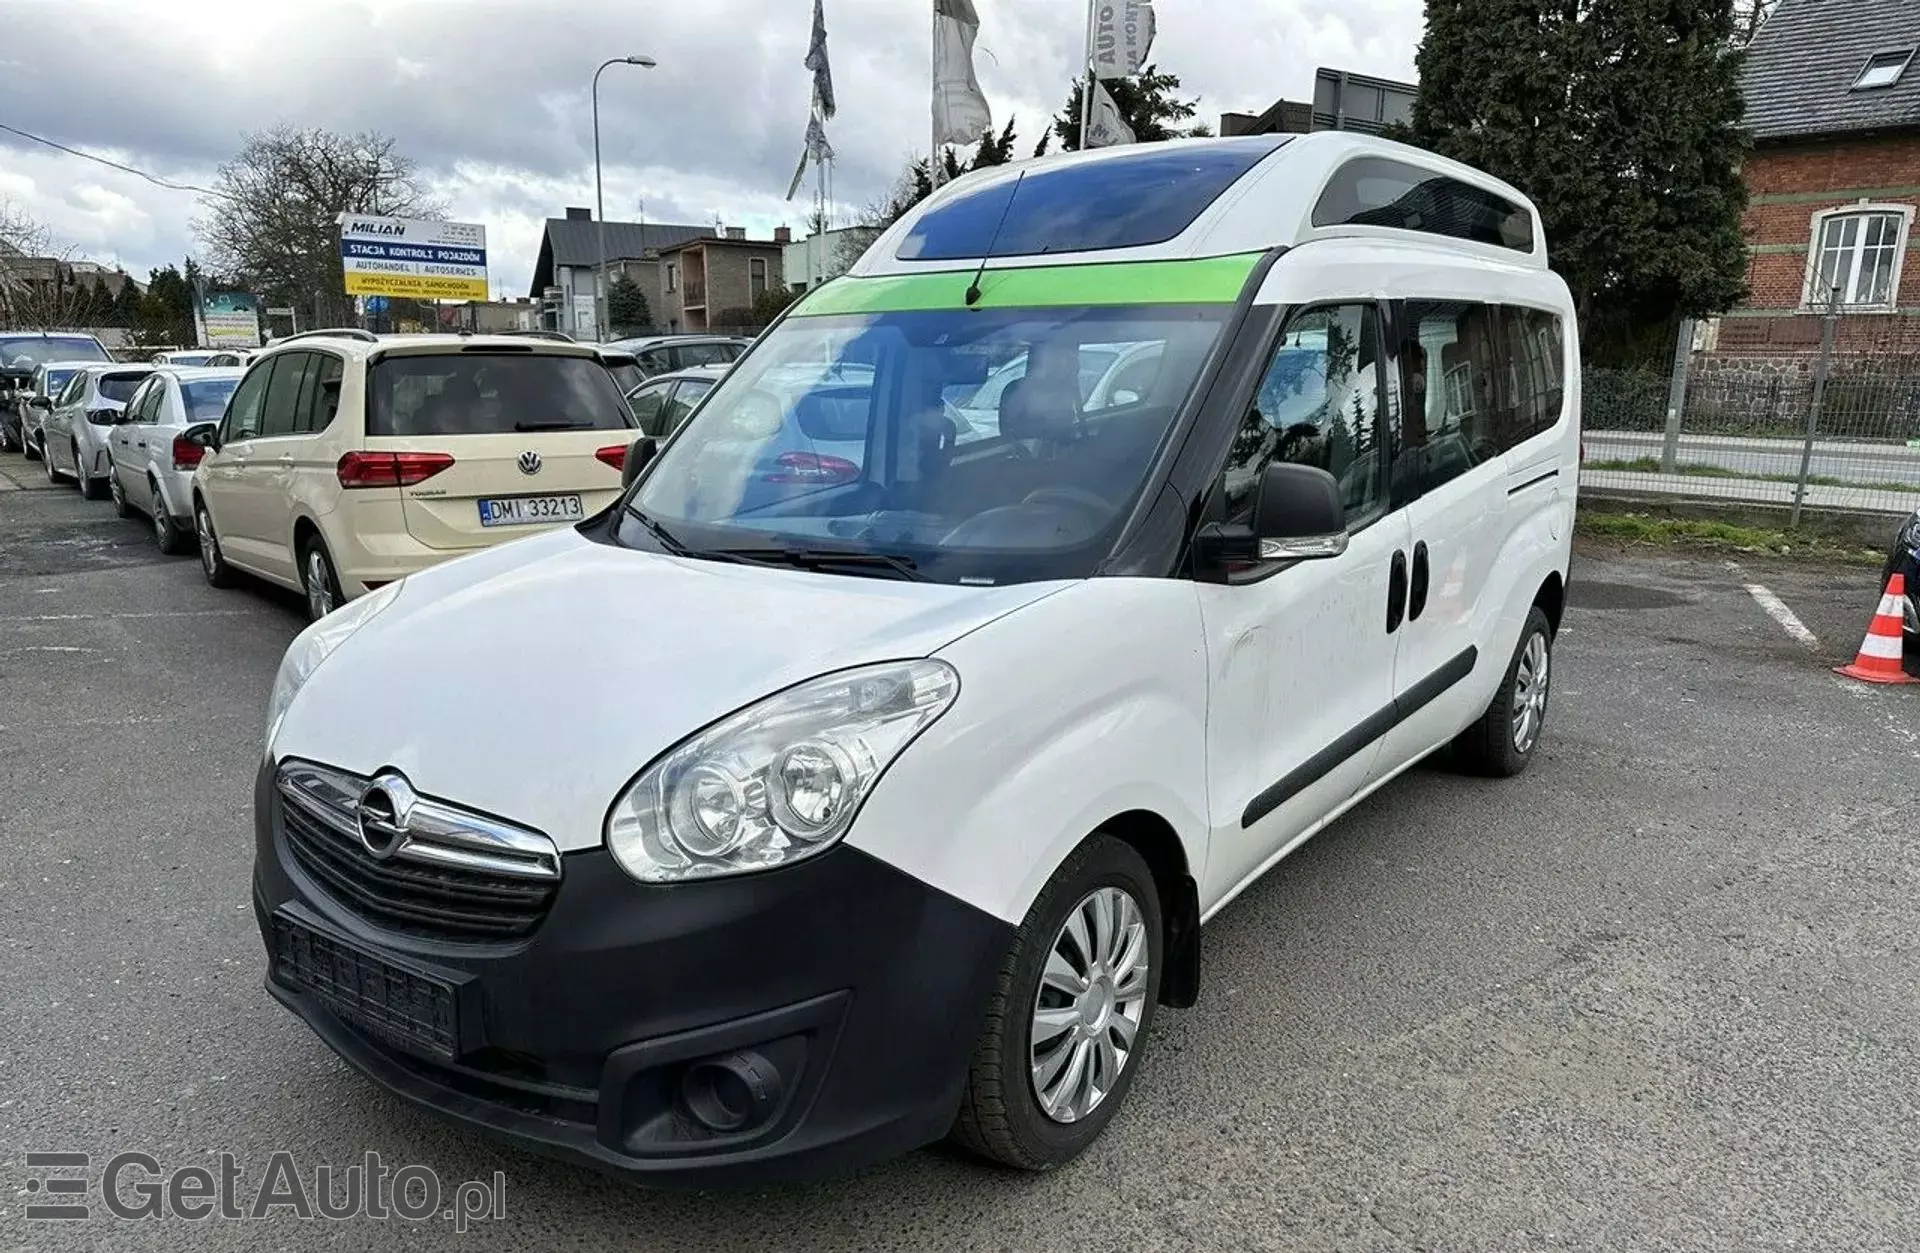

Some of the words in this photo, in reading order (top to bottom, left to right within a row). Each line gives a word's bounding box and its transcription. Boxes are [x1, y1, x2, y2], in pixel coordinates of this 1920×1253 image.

[1097, 6, 1115, 64] AUTO
[351, 222, 406, 236] MILIAN
[350, 244, 385, 256] STACJA
[389, 247, 433, 259] KONTROLI
[356, 260, 411, 272] AUTOHANDEL
[424, 265, 477, 276] AUTOSERWIS
[490, 500, 521, 519] DMI
[529, 498, 580, 517] 33213
